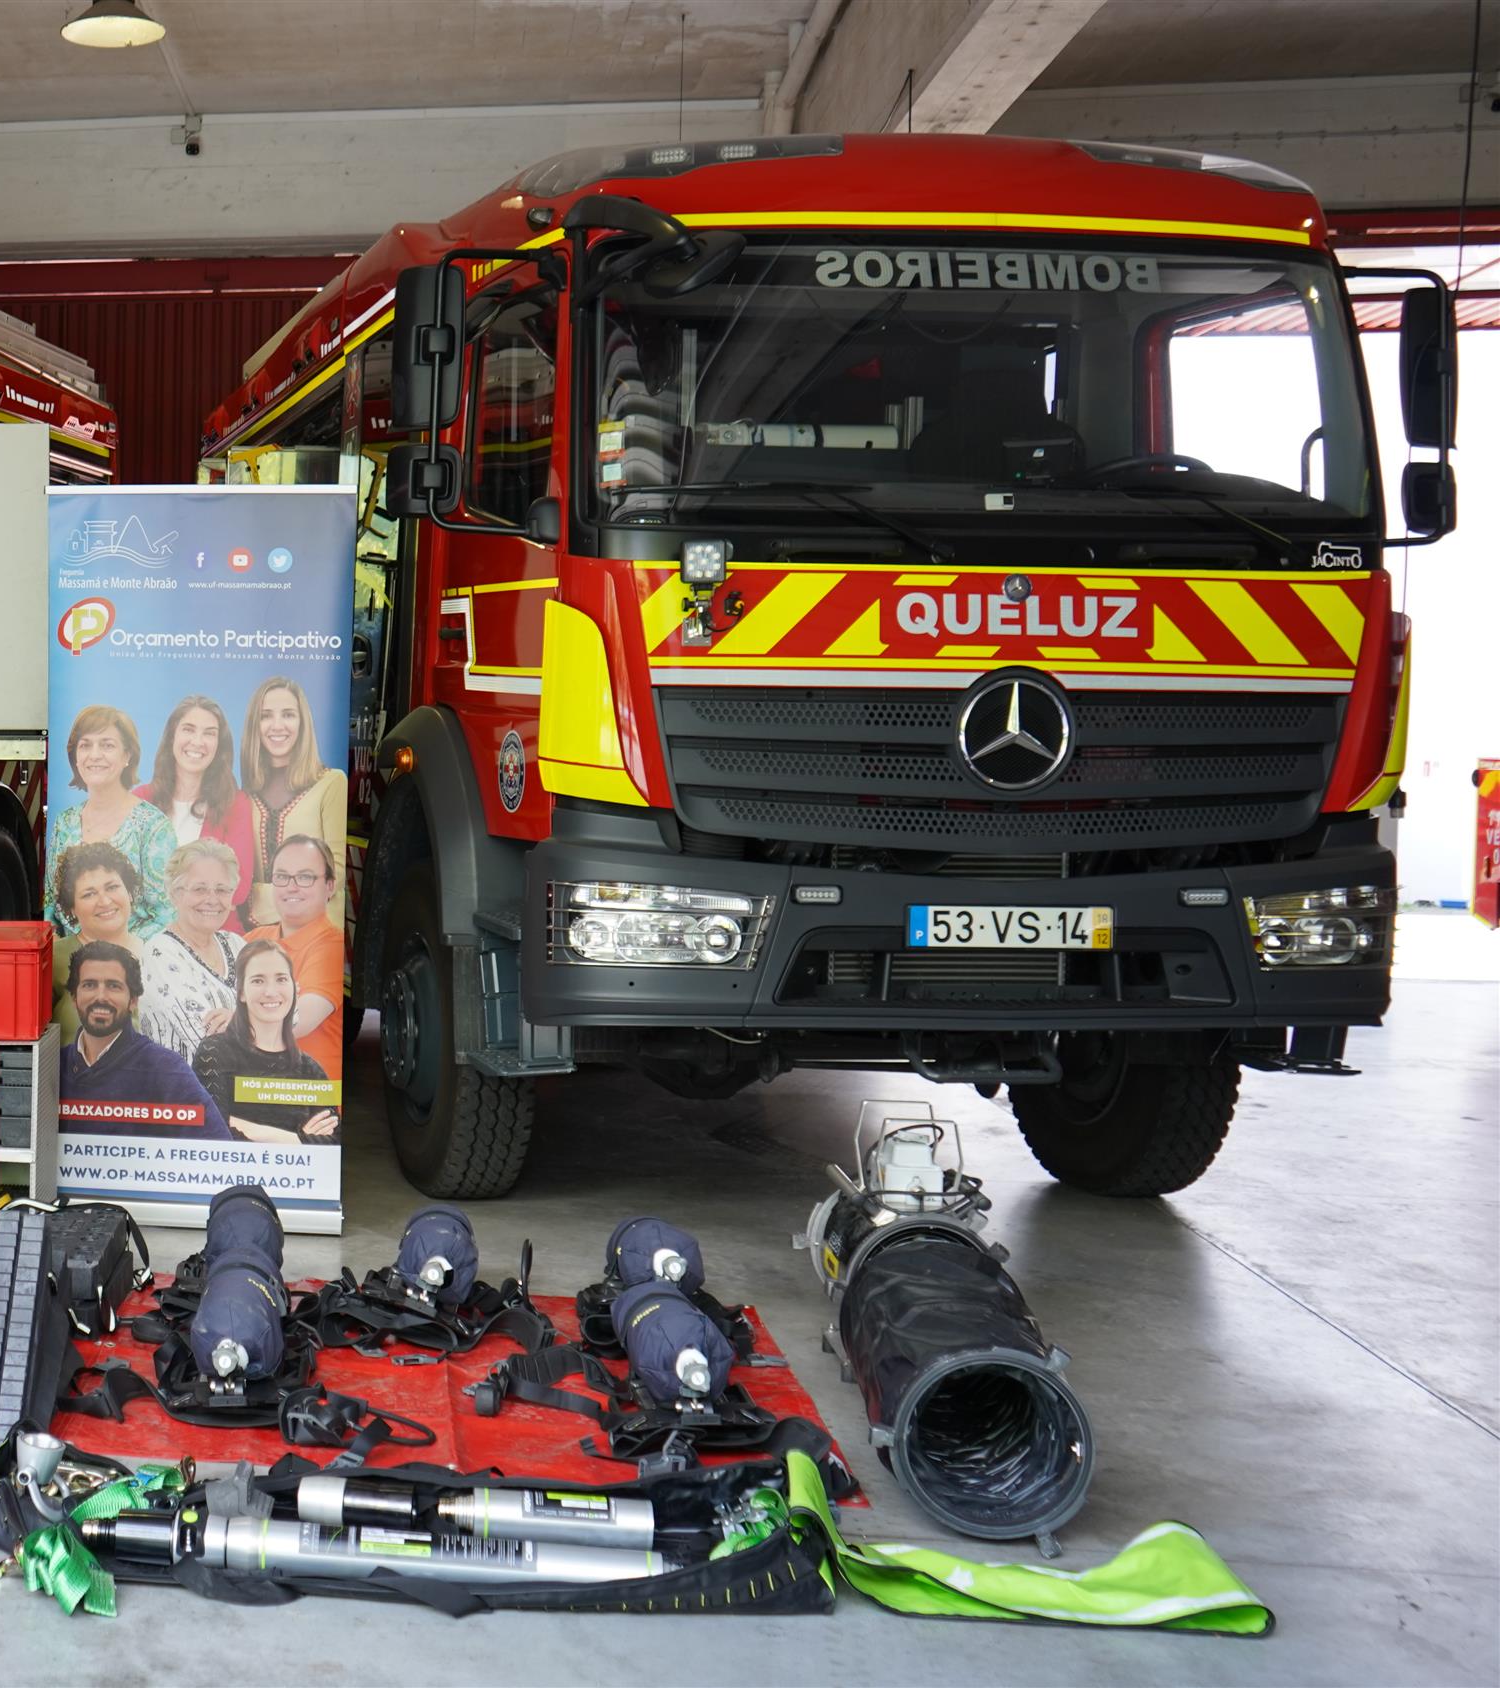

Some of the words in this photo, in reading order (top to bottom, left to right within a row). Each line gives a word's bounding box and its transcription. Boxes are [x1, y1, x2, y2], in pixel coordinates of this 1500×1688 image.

[1310, 552, 1363, 570] JACINTO
[58, 576, 101, 589] Massamá
[102, 579, 109, 589] e
[110, 577, 142, 589] Monte
[143, 577, 178, 590] Abraão
[895, 592, 1139, 639] QUELUZ
[109, 628, 219, 650] Orçamento
[224, 630, 342, 652] Participativo
[915, 930, 924, 940] P
[1097, 933, 1108, 945] 12
[242, 1080, 262, 1090] NÓS
[263, 1081, 334, 1092] APRESENTÁMOS
[257, 1093, 271, 1101] UM
[58, 1103, 150, 1119] BAIXADORES
[152, 1106, 174, 1119] DO
[176, 1107, 197, 1121] OP
[155, 1148, 166, 1160] A
[170, 1149, 257, 1165] FREGUESIA
[262, 1150, 270, 1165] É
[275, 1154, 312, 1167] SUA!
[59, 1166, 315, 1190] WWW.OP-MASSAMAMABRAAO.PT
